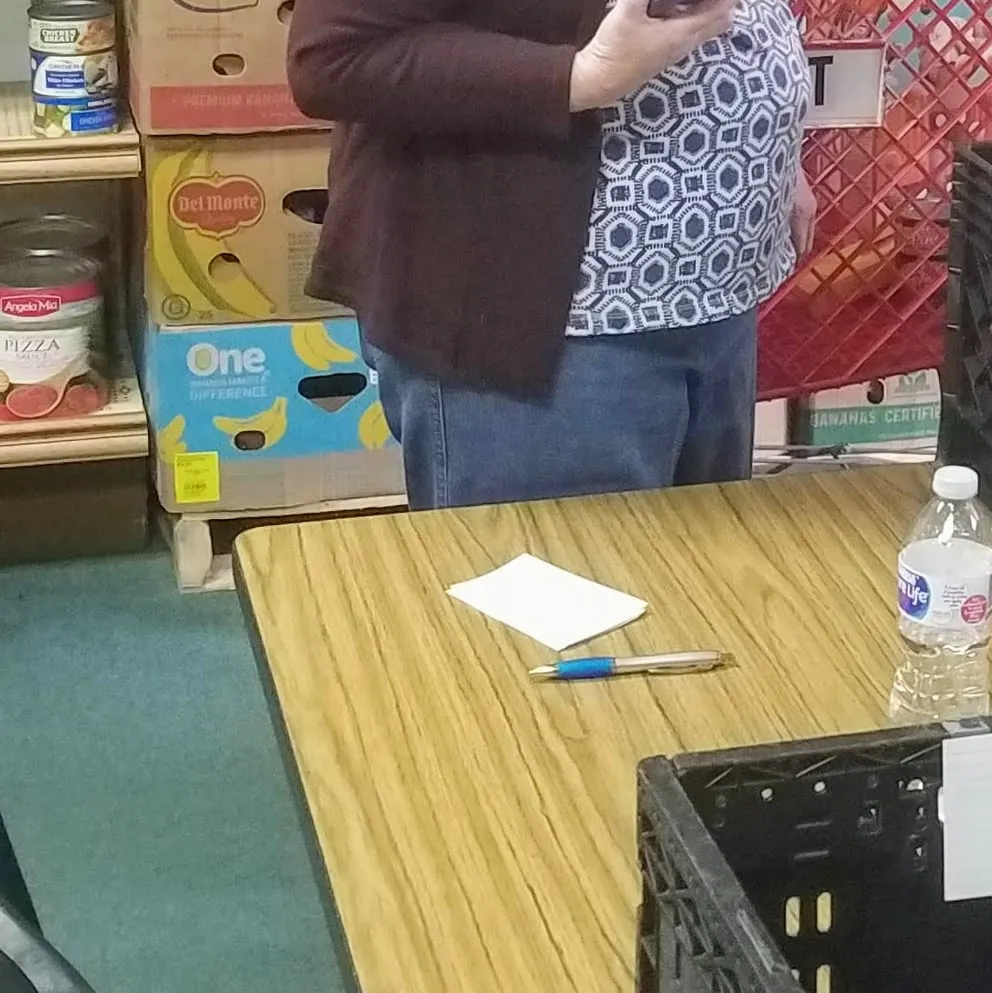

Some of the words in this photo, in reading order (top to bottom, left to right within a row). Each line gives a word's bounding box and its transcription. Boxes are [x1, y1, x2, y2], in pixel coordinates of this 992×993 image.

[182, 93, 242, 108] PREMIUM
[177, 195, 205, 213] Del
[206, 193, 258, 212] Monte
[4, 299, 38, 314] Angela
[38, 299, 59, 312] Mia
[4, 338, 61, 354] PIZZA
[186, 342, 266, 377] One
[189, 384, 268, 402] DIFFERENCE
[809, 410, 878, 428] BANANAS
[884, 406, 942, 424] CERTIFIE
